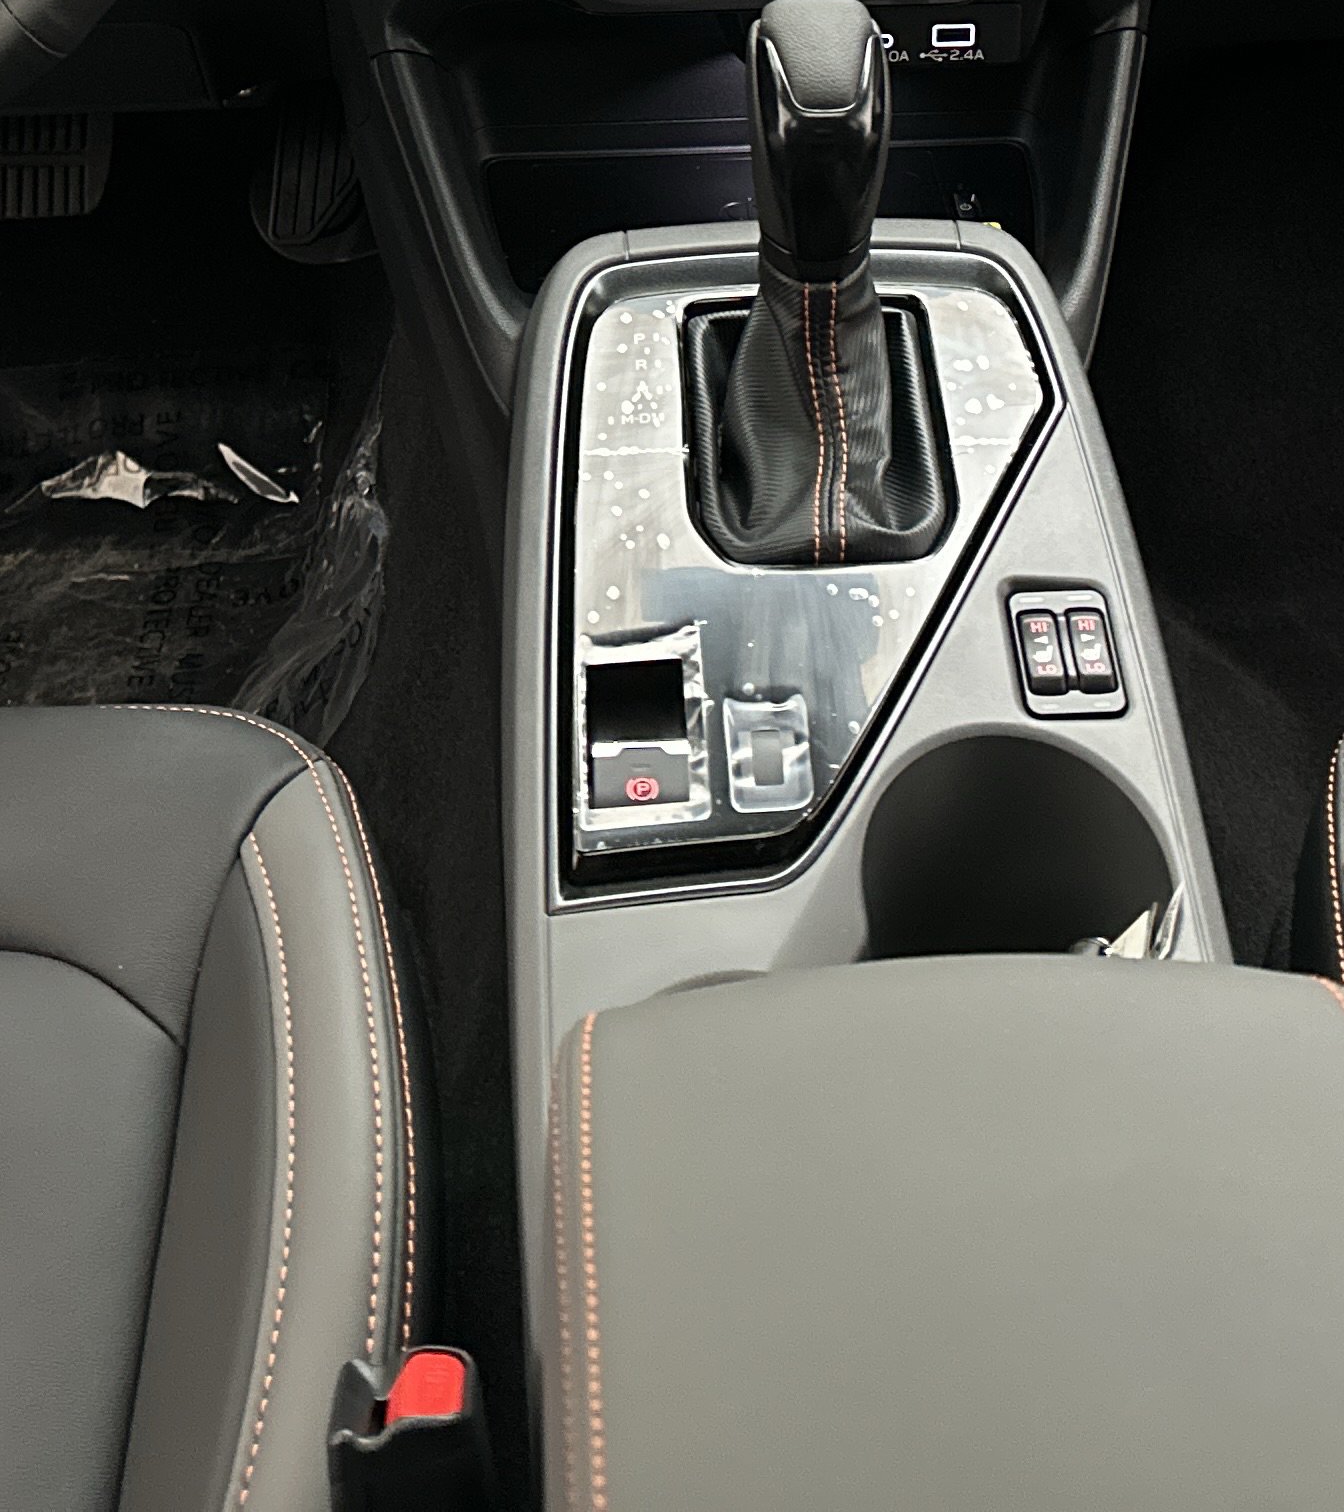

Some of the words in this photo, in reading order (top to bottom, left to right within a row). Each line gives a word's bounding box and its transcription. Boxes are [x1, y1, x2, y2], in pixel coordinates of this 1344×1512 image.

[949, 49, 985, 62] 2.4A
[633, 333, 646, 345] P
[635, 359, 647, 370] R
[1030, 621, 1048, 633] HI
[1077, 619, 1095, 631] HI
[1037, 664, 1057, 675] LO
[1085, 662, 1106, 673] LO
